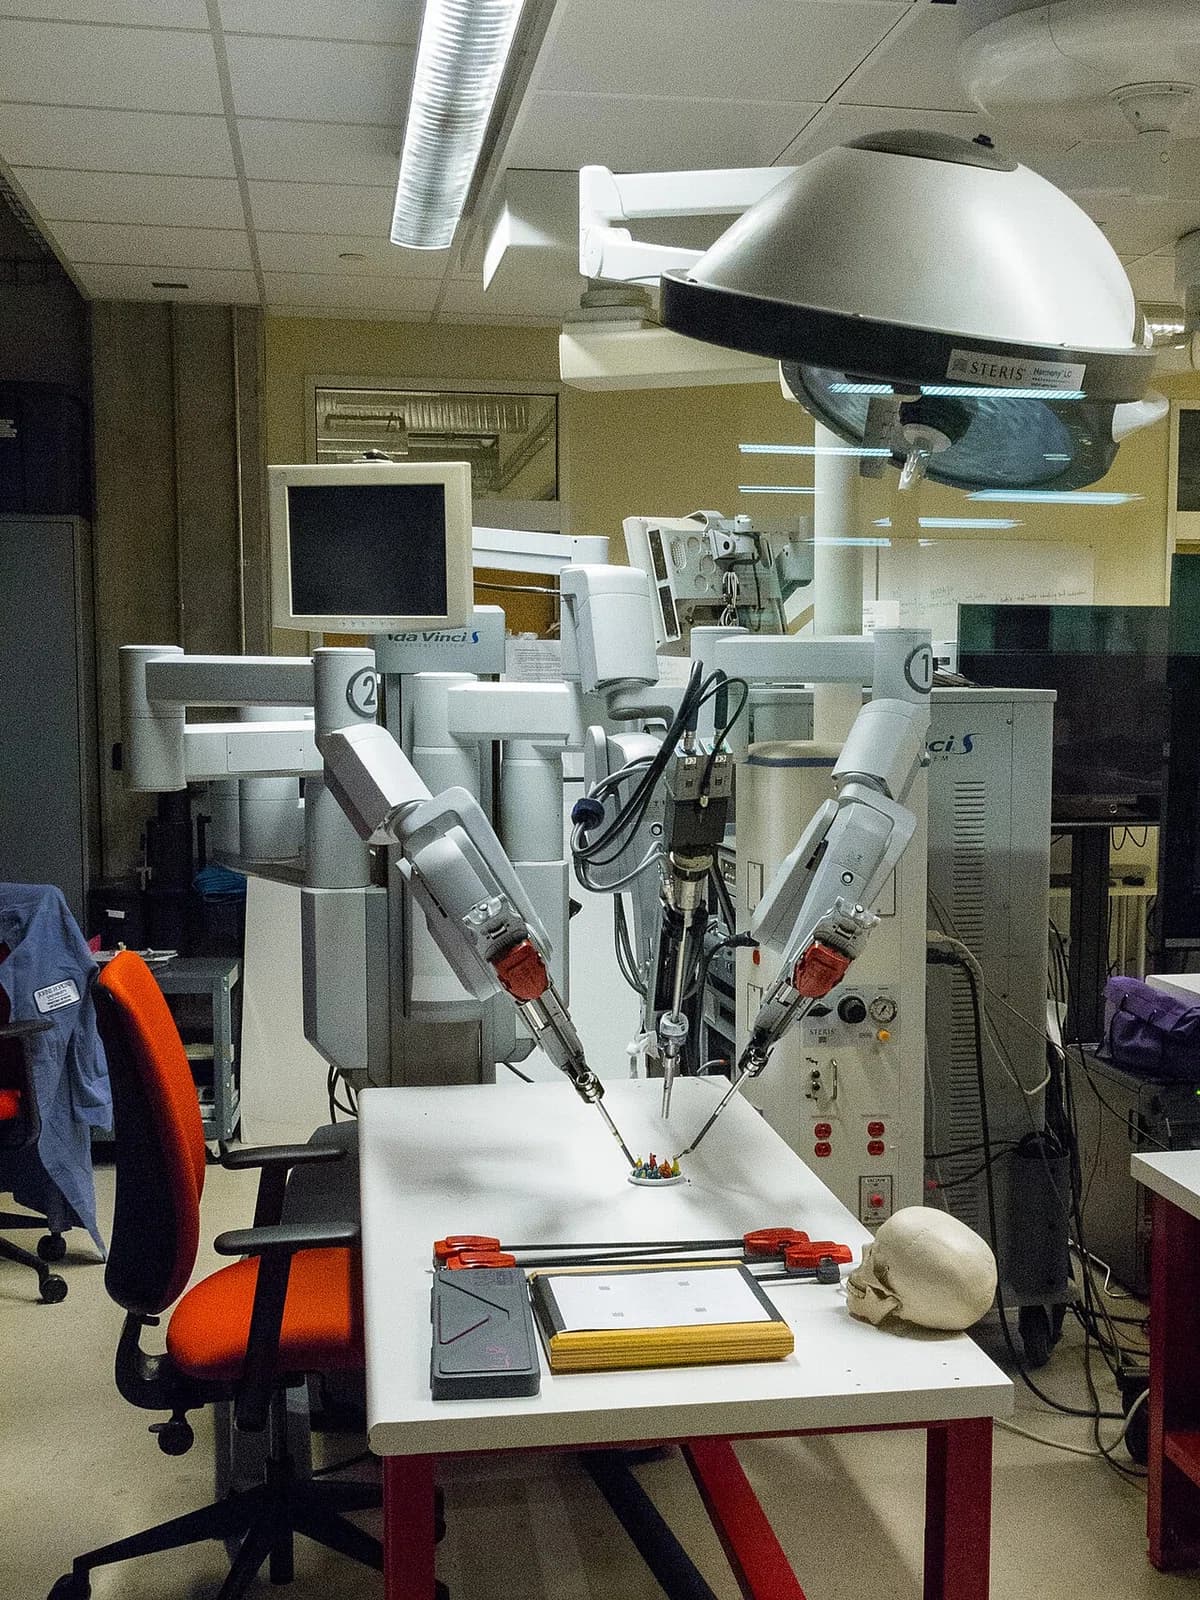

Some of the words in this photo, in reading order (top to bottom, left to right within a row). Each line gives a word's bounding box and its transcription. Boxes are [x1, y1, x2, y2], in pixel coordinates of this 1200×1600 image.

[970, 361, 1025, 380] STERIS
[422, 631, 467, 642] Vinci
[922, 654, 929, 682] 1
[363, 675, 376, 706] 2
